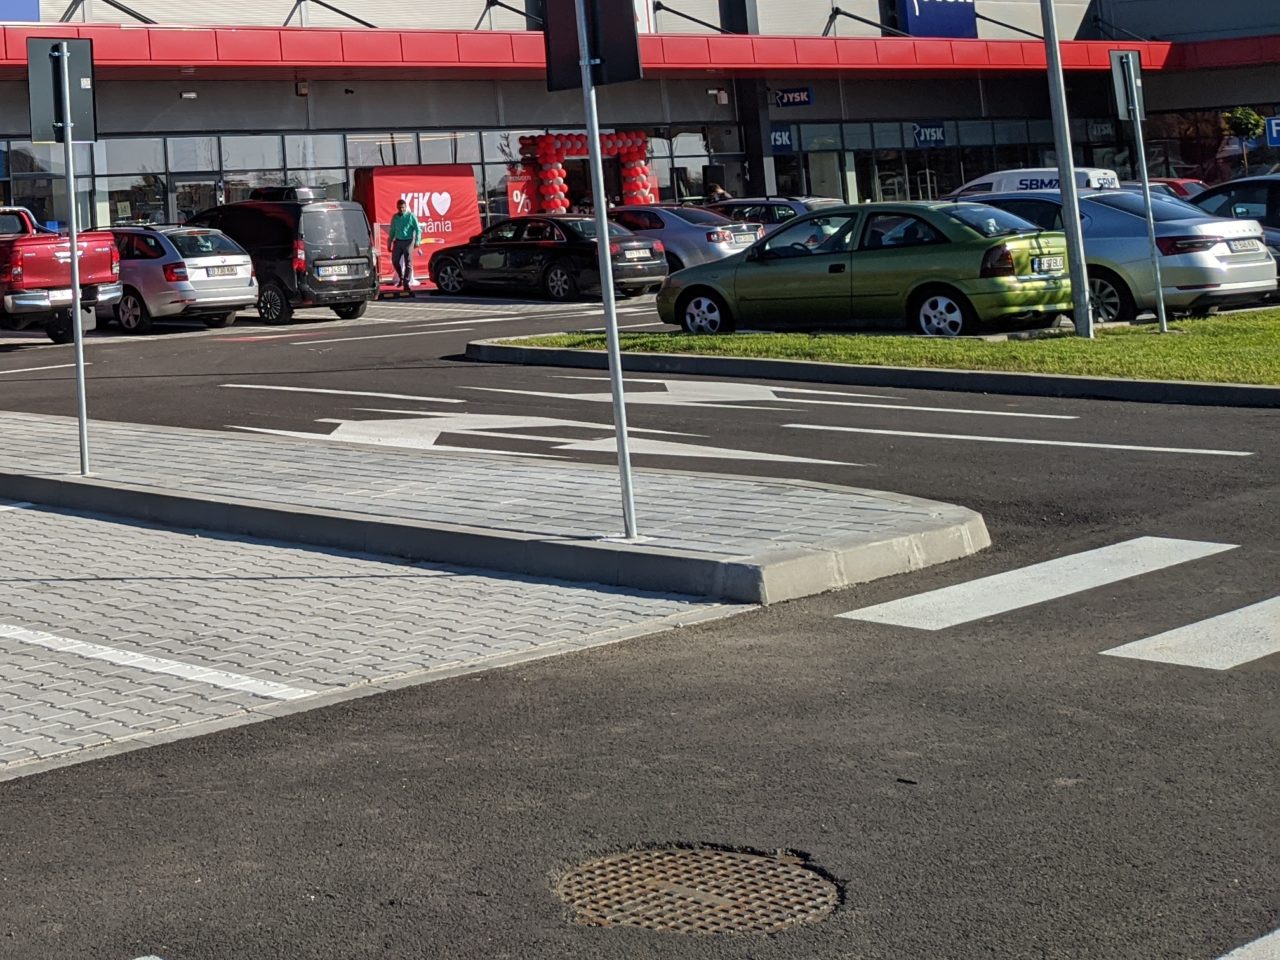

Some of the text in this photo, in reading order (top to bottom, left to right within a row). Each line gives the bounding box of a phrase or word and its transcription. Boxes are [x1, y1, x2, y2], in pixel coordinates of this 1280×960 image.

[782, 91, 808, 103] JYSK
[771, 131, 791, 145] YSK
[920, 127, 944, 141] JYSK
